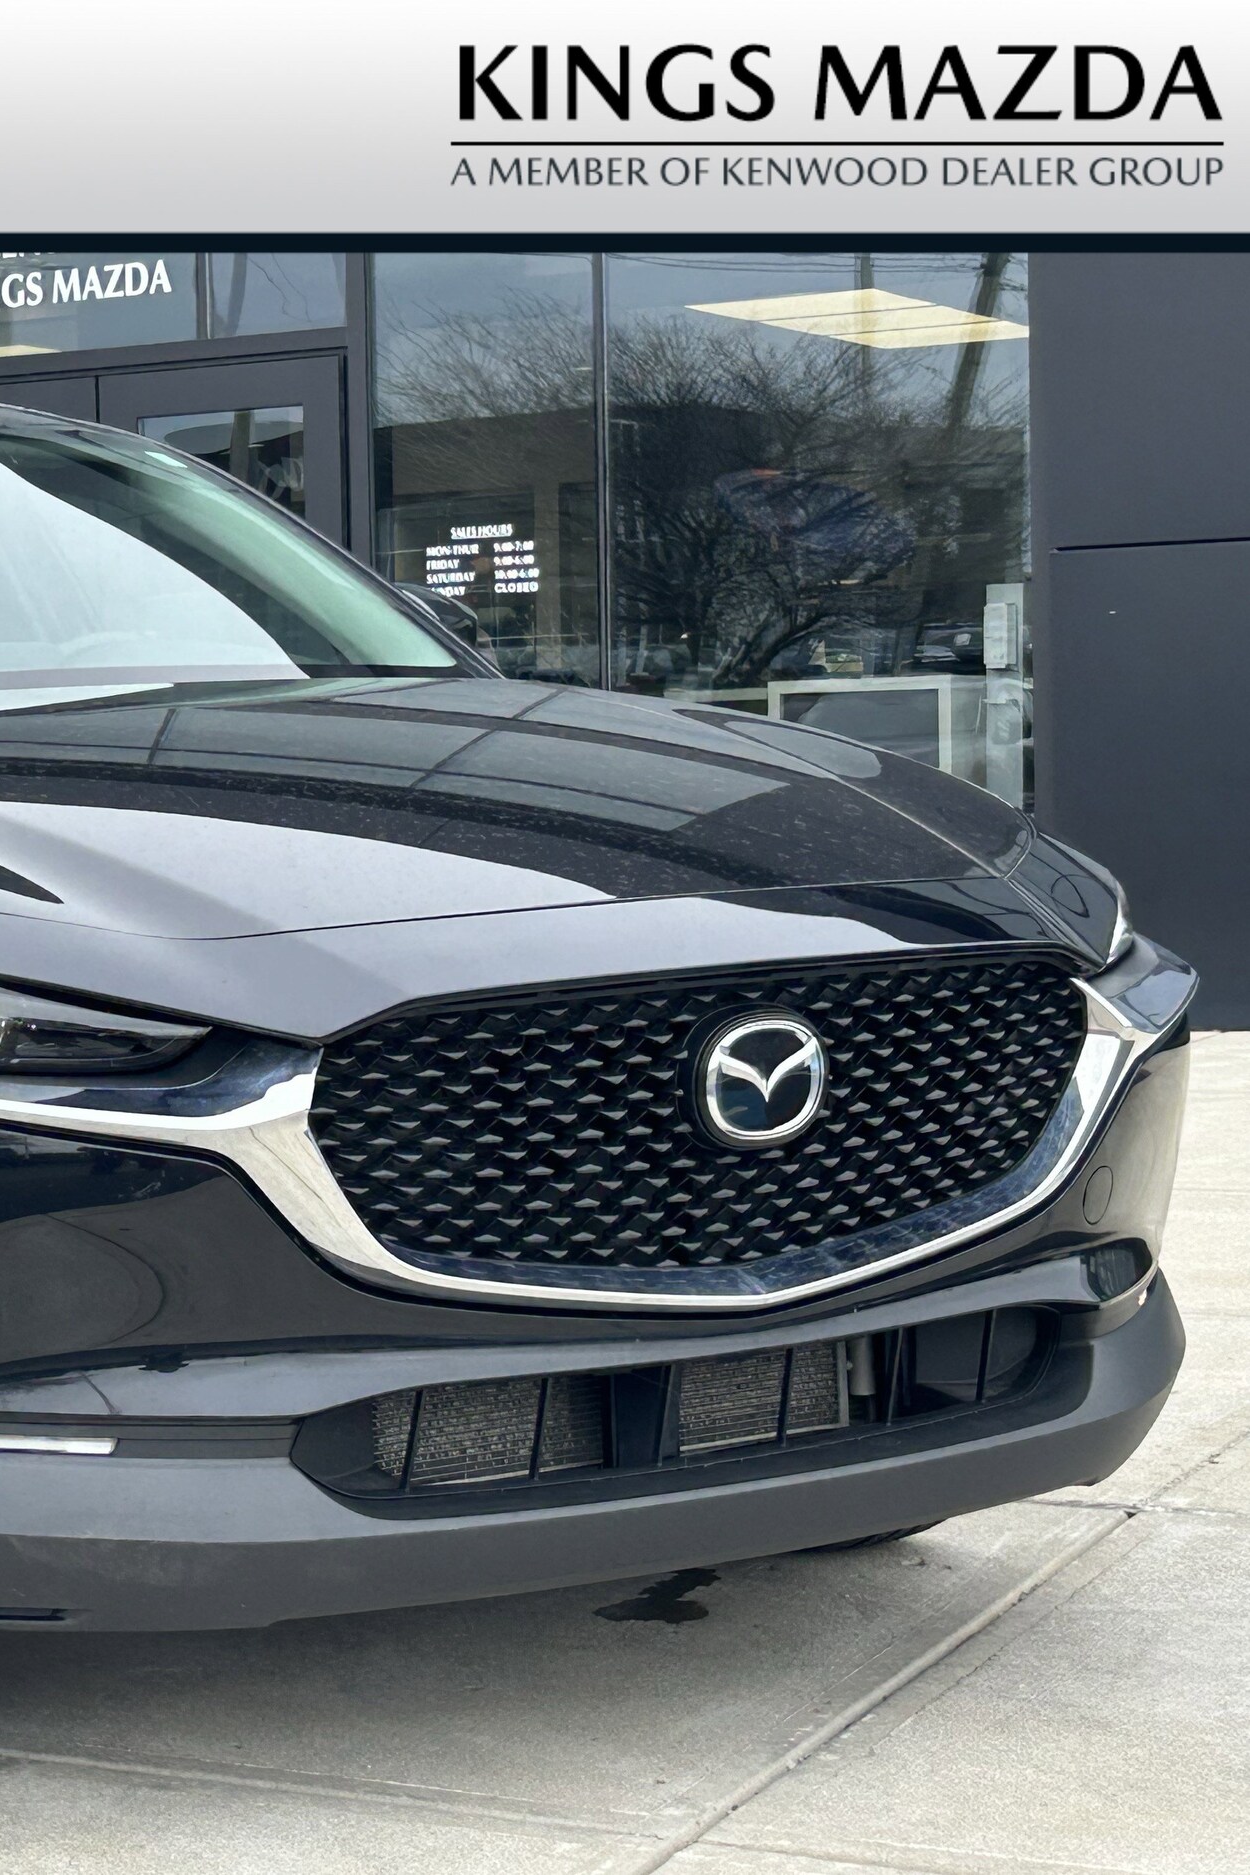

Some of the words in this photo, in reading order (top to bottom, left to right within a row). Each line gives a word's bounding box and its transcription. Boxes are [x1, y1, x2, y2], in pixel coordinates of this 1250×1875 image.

[52, 259, 172, 304] MAZDA
[426, 559, 460, 570] FRIDAY
[426, 572, 476, 584] SATURDAY
[494, 581, 539, 593] CLOSED
